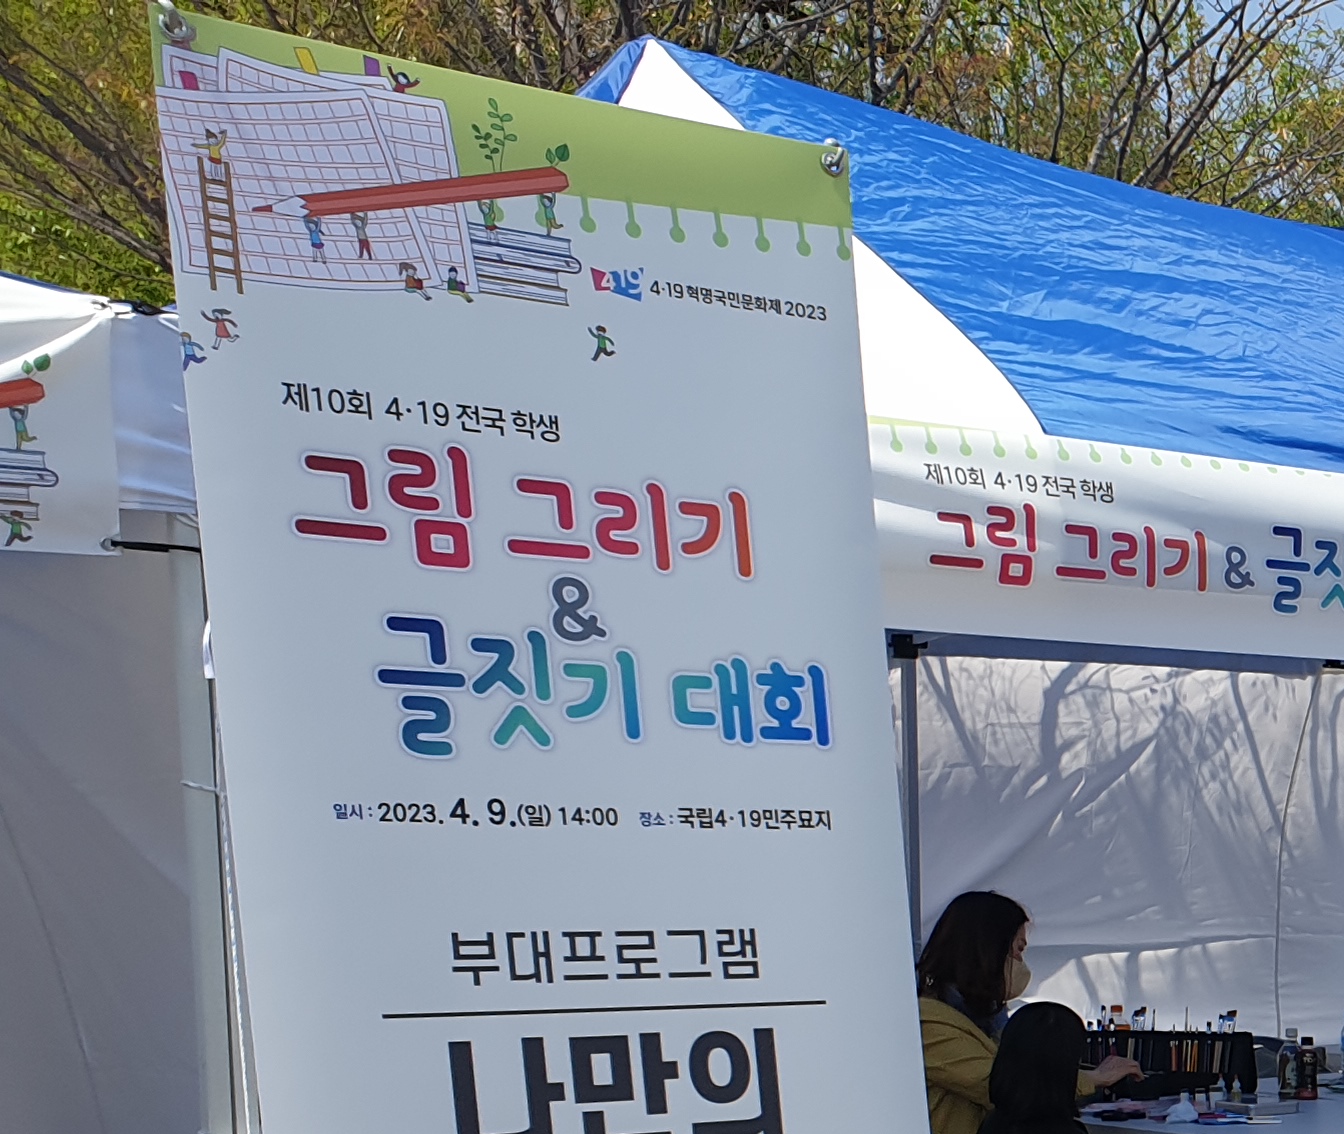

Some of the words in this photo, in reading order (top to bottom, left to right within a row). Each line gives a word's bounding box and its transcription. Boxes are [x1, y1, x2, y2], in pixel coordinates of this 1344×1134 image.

[686, 284, 782, 315] 혁명국민문화제
[785, 301, 827, 322] 2023
[281, 381, 373, 420] 제10회
[384, 396, 450, 427] 4·19
[456, 403, 506, 437] 전국
[510, 409, 561, 443] 학생
[293, 444, 473, 571] 그림
[506, 477, 754, 580] 그리기
[923, 462, 986, 489] 제10회
[1041, 474, 1076, 499] 전국
[1079, 478, 1115, 503] 학생
[929, 501, 1038, 587] 그림
[1055, 524, 1209, 594] 그리기
[1223, 544, 1255, 591] &
[551, 574, 607, 643] &
[378, 614, 642, 758] 글짓기
[670, 655, 832, 750] 대회
[557, 806, 619, 827] 14:00
[451, 927, 762, 986] 부대프로그램
